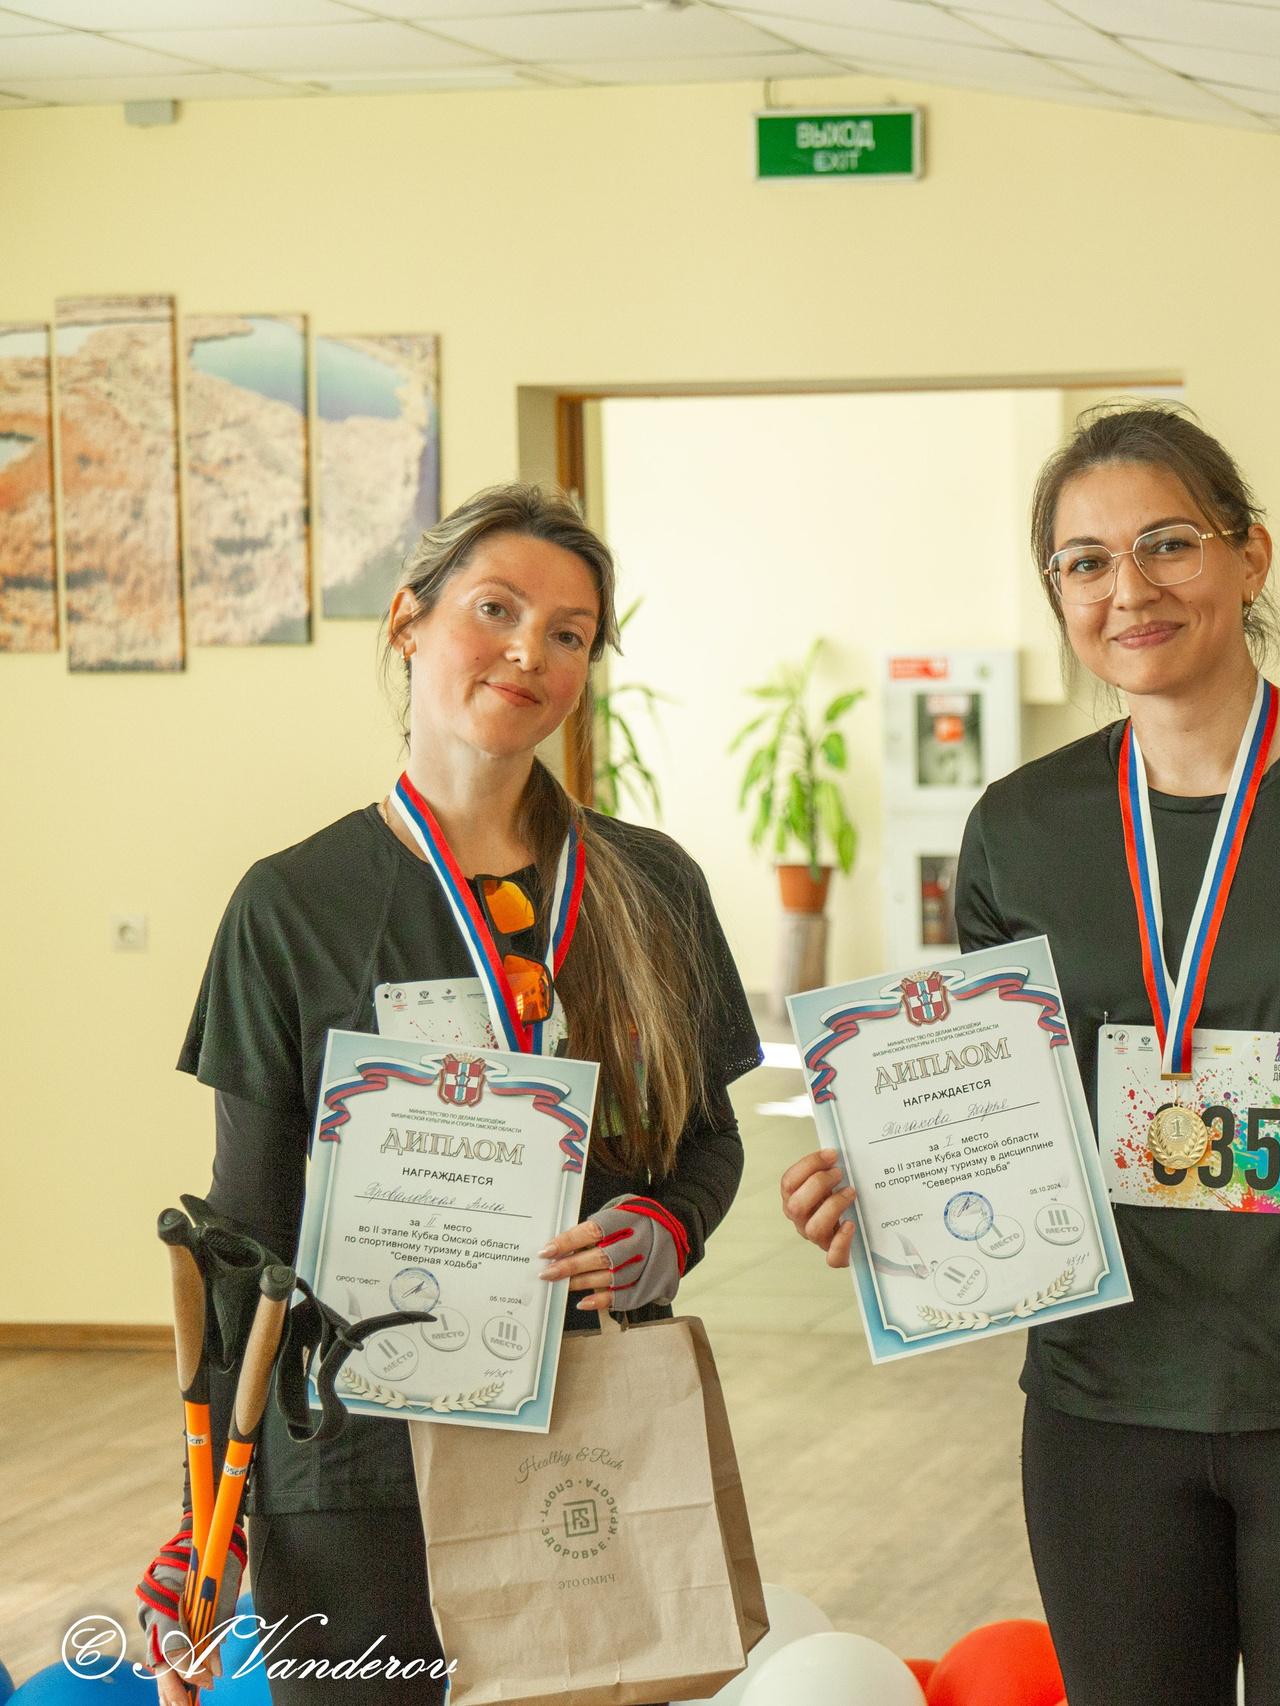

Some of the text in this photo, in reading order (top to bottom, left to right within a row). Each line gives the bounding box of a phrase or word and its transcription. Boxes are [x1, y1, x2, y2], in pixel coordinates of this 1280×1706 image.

[795, 119, 876, 151] ВЫХОД
[813, 149, 862, 173] EXIT
[887, 1034, 927, 1047] МИНИСТЕРСТВО
[935, 1028, 952, 1037] ДЕЛАМ
[935, 1035, 955, 1043] СПОРТА
[954, 1028, 976, 1039] ОМСКОЙ
[976, 1023, 1000, 1034] ОБЛАСТИ
[874, 1036, 1012, 1095] ДИПЛОМ
[903, 1078, 992, 1108] НАГРАЖДАЕТСЯ
[408, 1108, 450, 1118] МИНИСТЕРСТВО
[457, 1114, 476, 1122] ДЕЛАМ
[455, 1120, 475, 1128] СПОРТА
[475, 1122, 498, 1131] ОМСКОЙ
[498, 1125, 522, 1134] ОБЛАСТИ
[1170, 1119, 1184, 1138] 1
[380, 1127, 526, 1166] ДИПЛОМ
[928, 1143, 940, 1152] за
[961, 1132, 989, 1145] место
[883, 1131, 1040, 1175] во II этапе Кубка Омской области
[874, 1140, 1054, 1190] по спортивному туризму в дисциплине
[402, 1167, 494, 1186] НАГРАЖДАЕТСЯ
[922, 1161, 1011, 1190] "Северная ходьба"
[1029, 1182, 1062, 1195] 05.10.2024
[409, 1219, 420, 1227] за
[443, 1222, 473, 1233] место
[880, 1213, 924, 1229] ОРОО "ОФСТ"
[1045, 1226, 1079, 1234] МЕСТО
[358, 1225, 520, 1250] во II этапе Кубка Омской области
[989, 1232, 1021, 1252] МЕСТО
[344, 1235, 530, 1265] по спортивному туризму в дисциплине
[390, 1251, 482, 1270] "Северная ходьба"
[335, 1275, 380, 1286] ОРОО "ОФСТ"
[956, 1269, 981, 1299] МЕСТО
[489, 1295, 522, 1305] 05.10.2024
[431, 1330, 465, 1341] МЕСТО
[489, 1336, 524, 1351] МЕСТО
[382, 1350, 414, 1374] МЕСТО
[514, 1446, 625, 1484] Healthy & Rich
[540, 1477, 619, 1560] ЗДОРОВЬЕ КРАСОТА СПОРТ
[558, 1573, 617, 1590] ЭТО ОМИЧ
